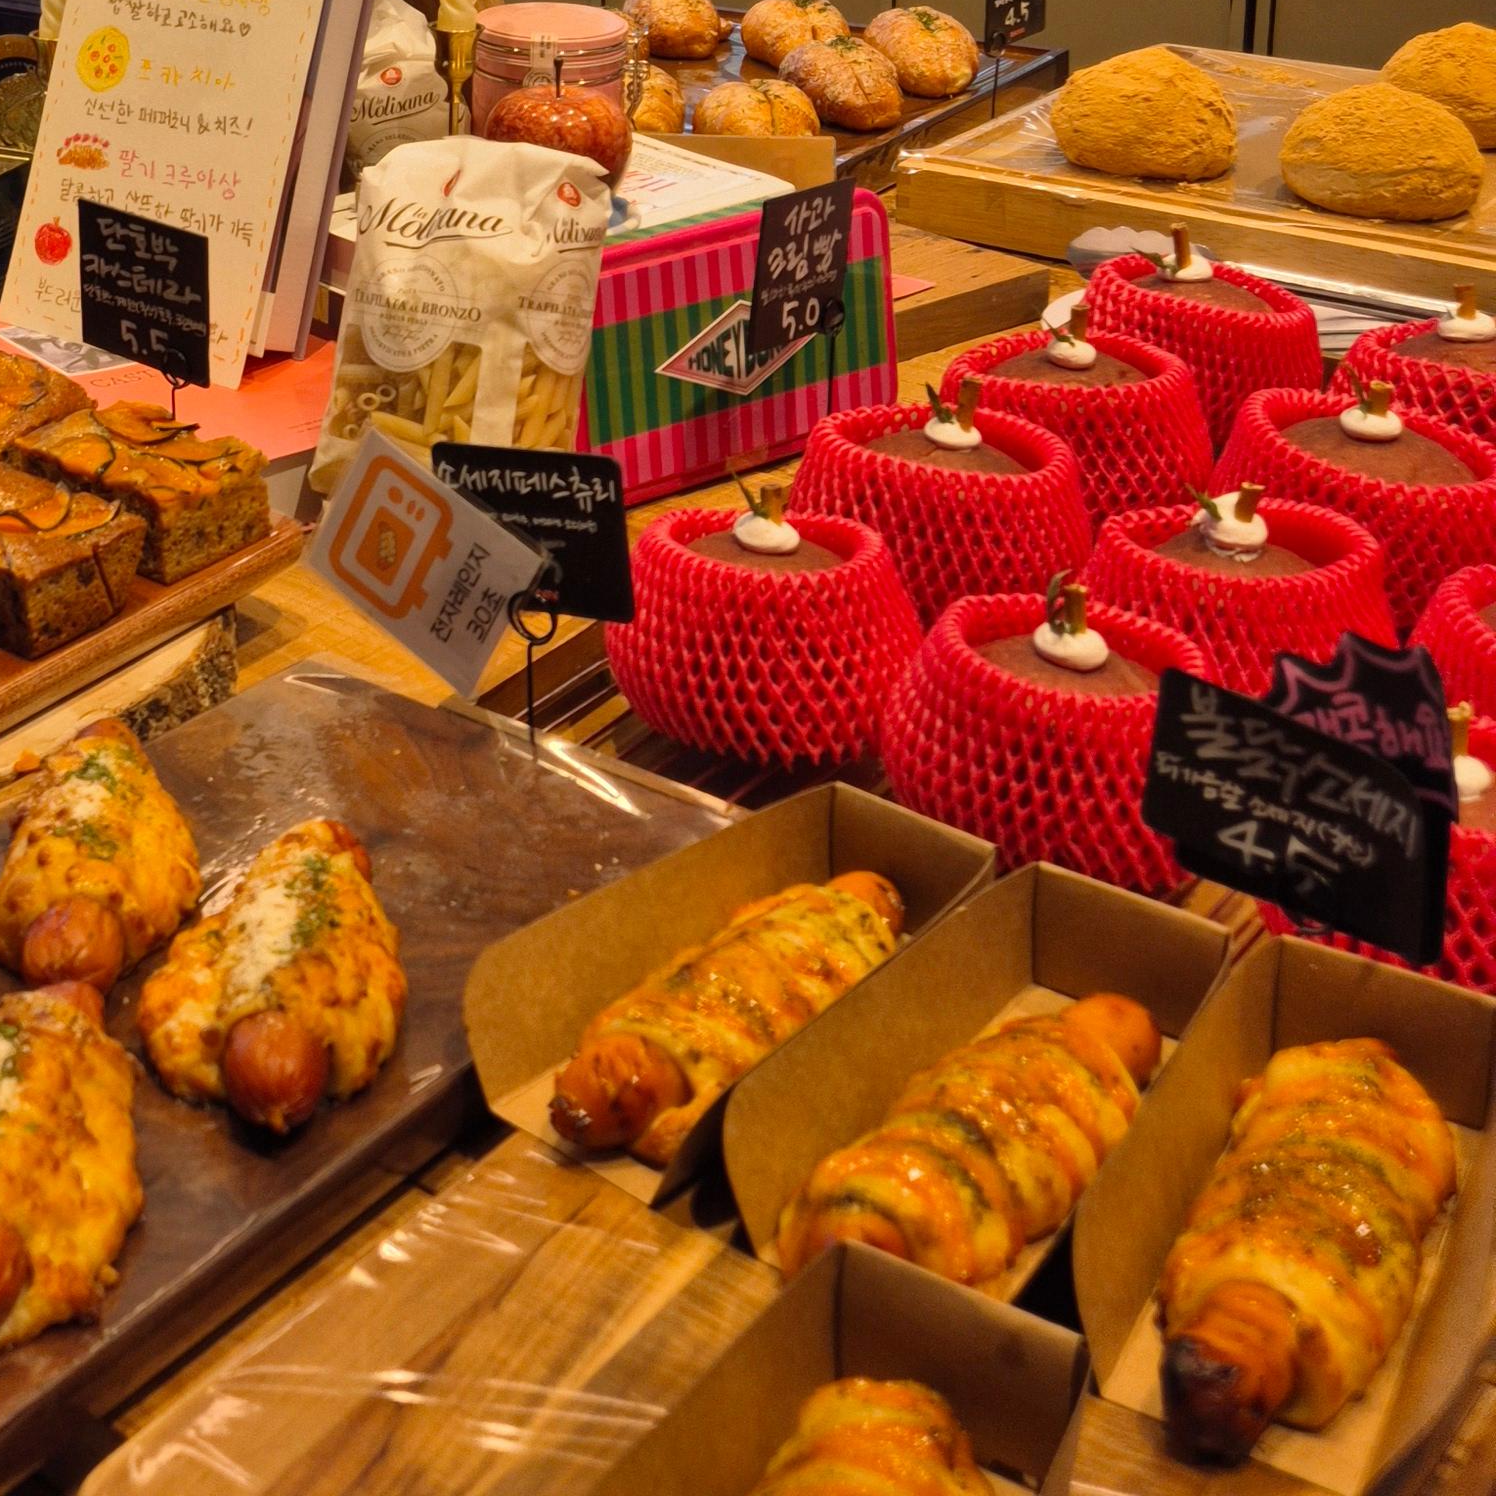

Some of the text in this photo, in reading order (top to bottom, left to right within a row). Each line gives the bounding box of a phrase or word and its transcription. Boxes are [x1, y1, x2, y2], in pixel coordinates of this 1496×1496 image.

[1004, 1, 1030, 26] 4.5
[84, 98, 134, 125] 신선한
[214, 114, 254, 139] 치즈!
[118, 149, 242, 201] 딸기 크루아상
[359, 195, 514, 244] Molana
[783, 196, 837, 237] 사과
[96, 217, 180, 273] 단호박
[81, 254, 203, 305] 카스테라
[421, 301, 482, 323] BRONZO
[781, 296, 821, 341] 5.0
[119, 319, 172, 357] 5.5
[90, 369, 157, 389] CAST
[430, 541, 491, 644] 전자레인지
[466, 586, 504, 641] 30초
